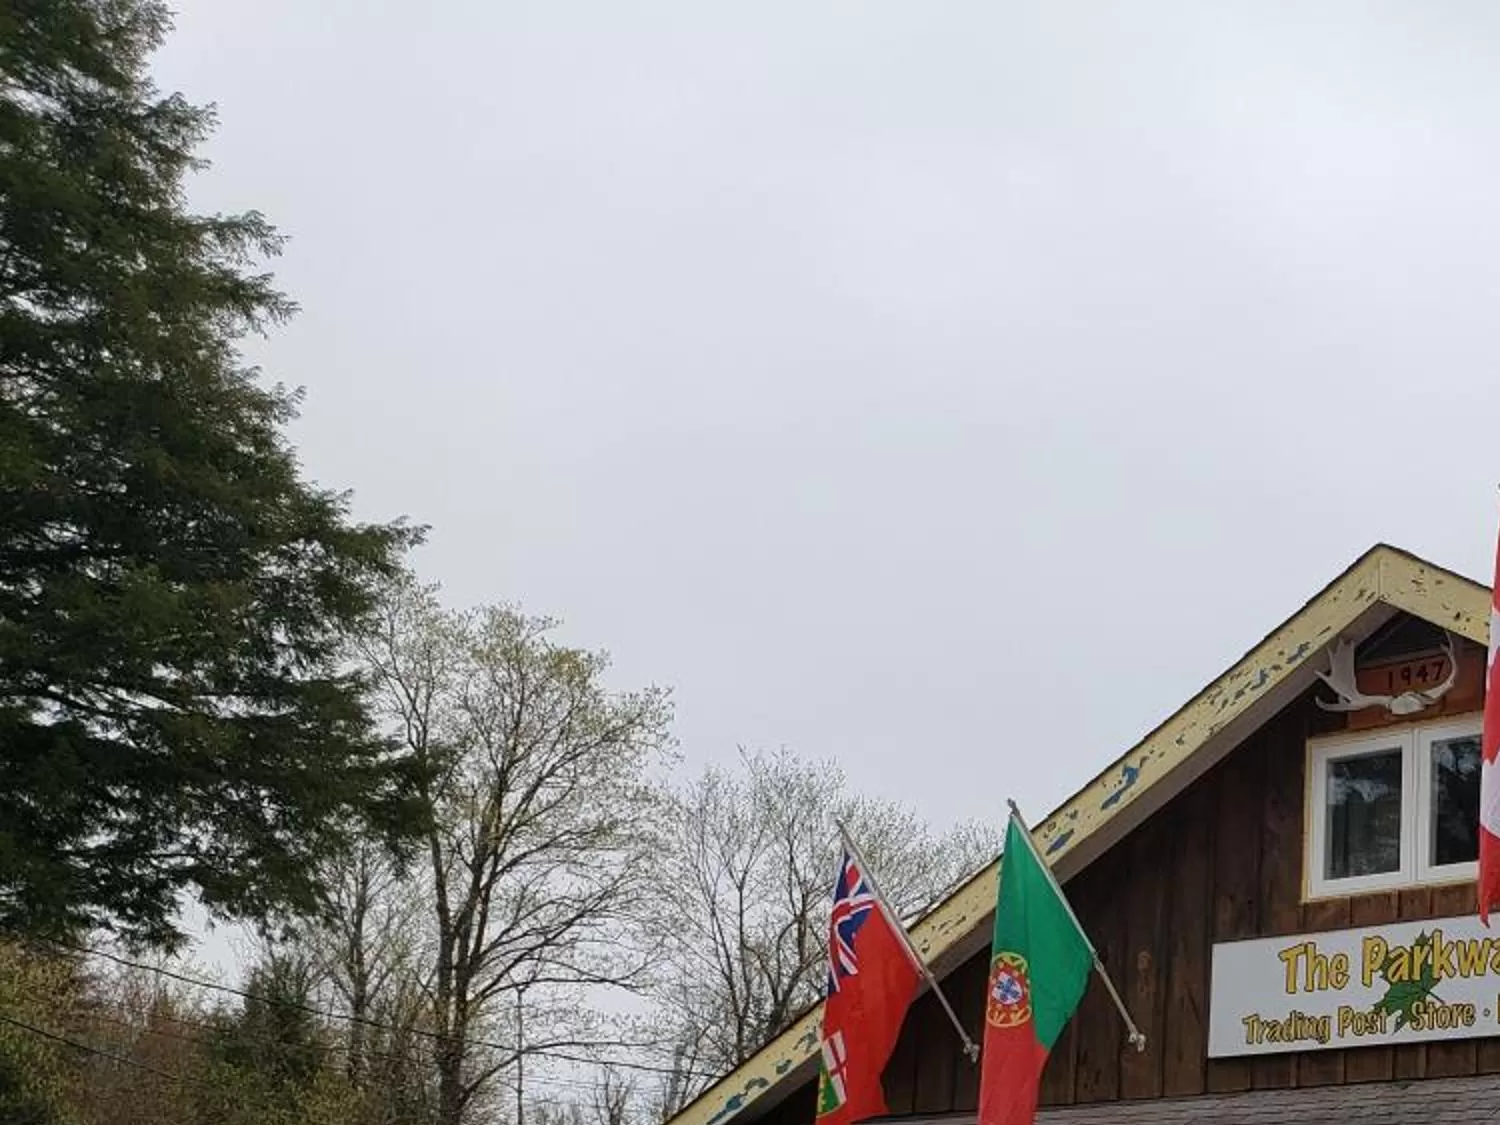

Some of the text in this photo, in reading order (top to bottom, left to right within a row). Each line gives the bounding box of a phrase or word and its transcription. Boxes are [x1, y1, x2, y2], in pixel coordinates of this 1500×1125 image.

[1388, 660, 1445, 688] 1947
[1279, 942, 1350, 995] The
[1242, 1010, 1331, 1045] Trading
[1337, 1006, 1388, 1039] Post
[1409, 999, 1475, 1031] Store
